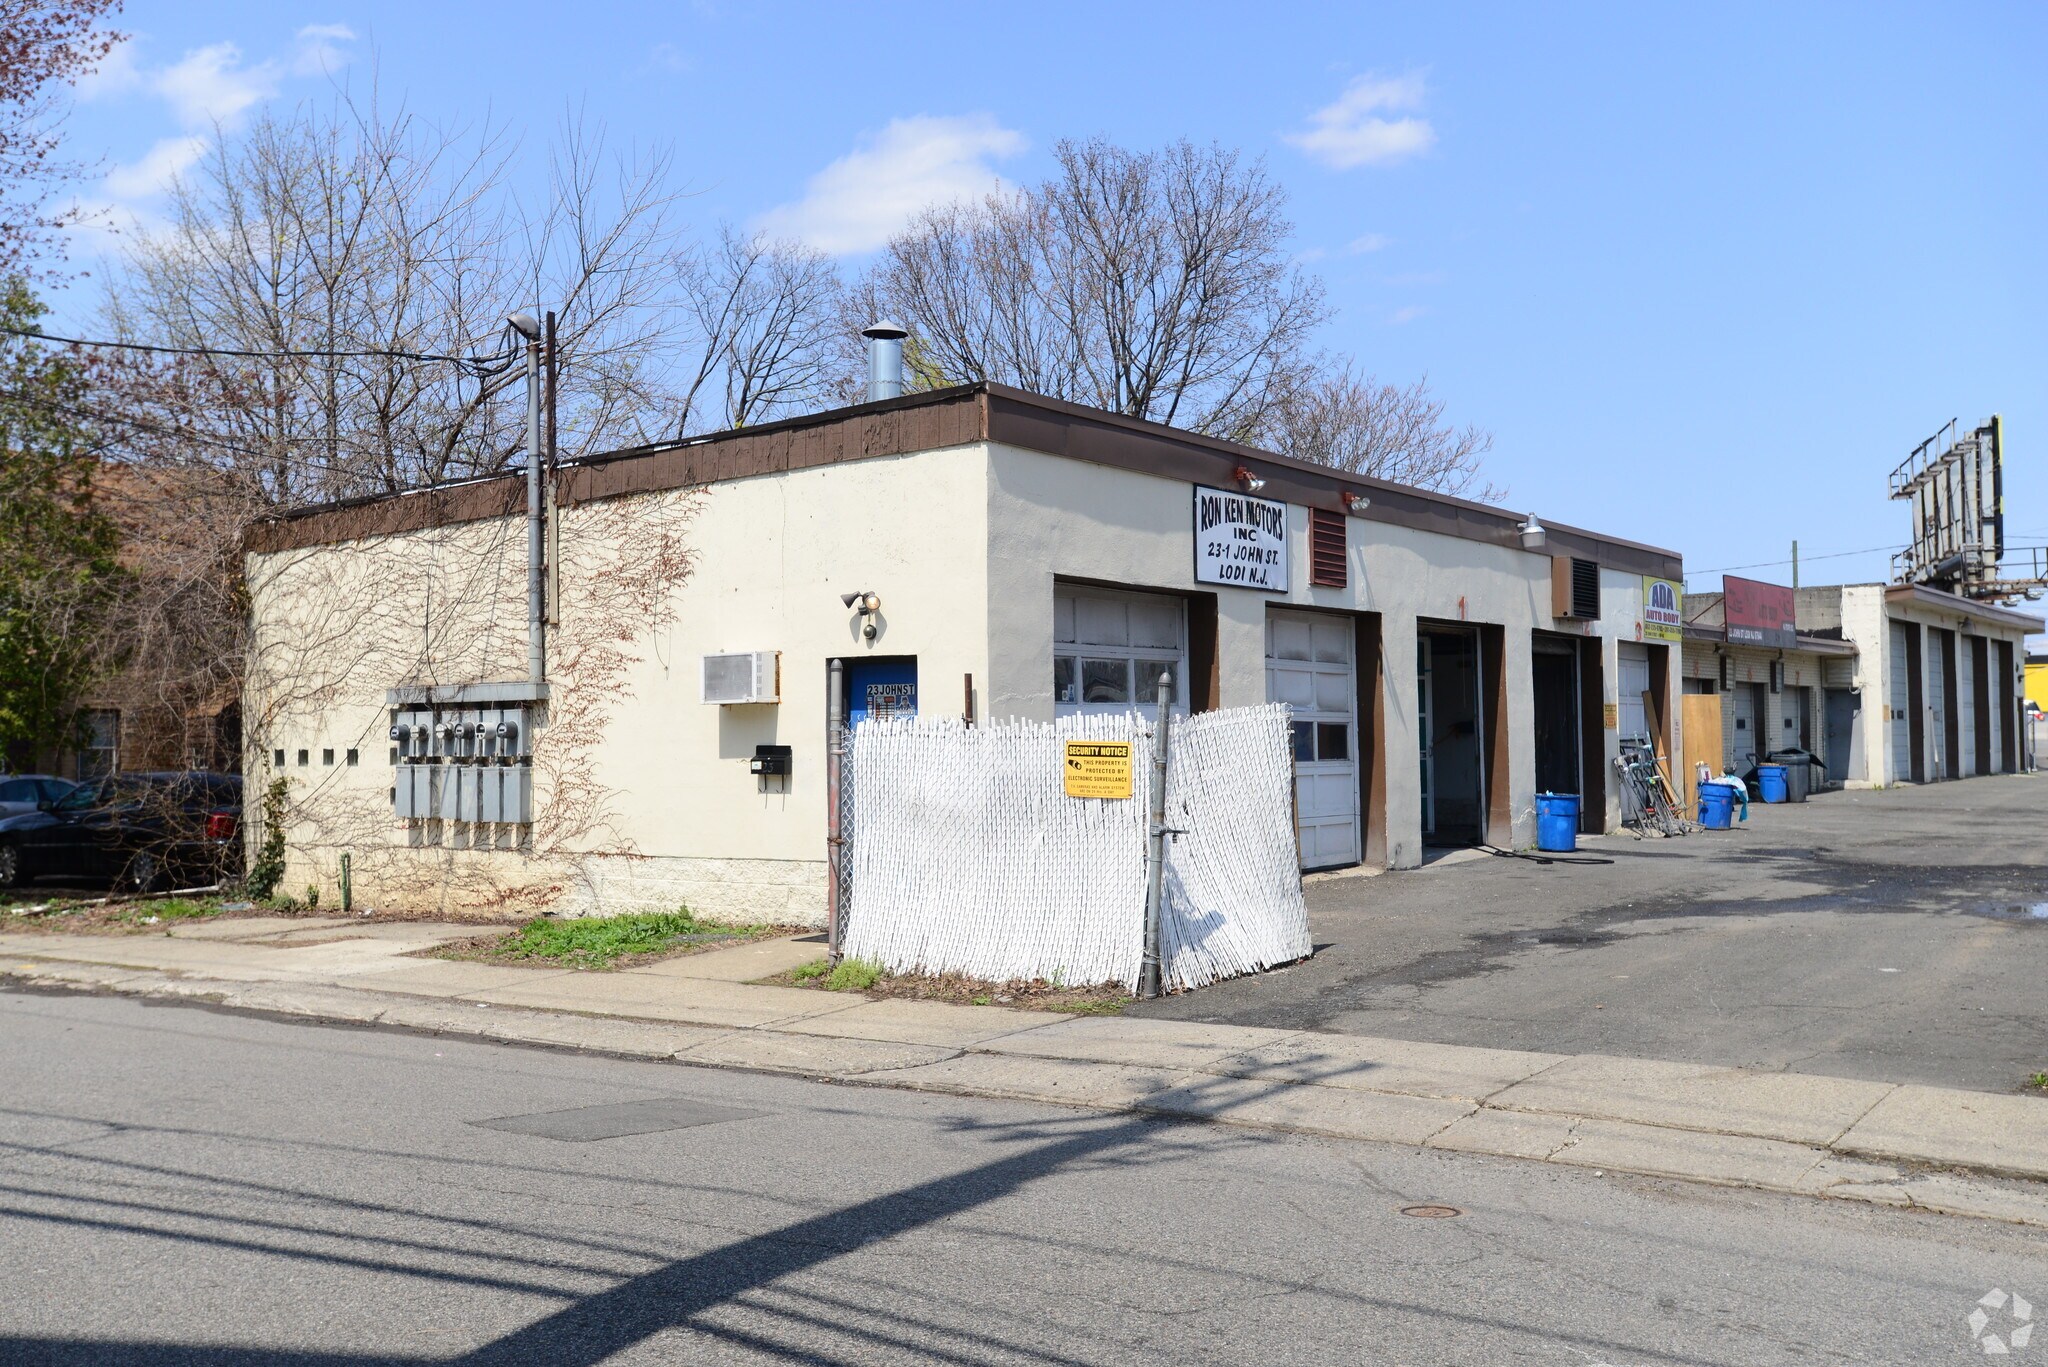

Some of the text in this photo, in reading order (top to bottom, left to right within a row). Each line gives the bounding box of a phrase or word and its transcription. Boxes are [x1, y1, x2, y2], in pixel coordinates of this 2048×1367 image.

[1201, 495, 1283, 541] RON KEN MOTORS
[1234, 528, 1256, 541] INC
[1208, 542, 1279, 565] 23-1 JOHN ST.
[1219, 564, 1267, 585] LODI N.J.
[1652, 584, 1674, 610] ADA
[1646, 609, 1679, 624] AUTO BODY
[1635, 622, 1642, 640] 3
[867, 684, 914, 696] 23 JOHN ST
[1069, 746, 1127, 756] SECURITY NOTICE
